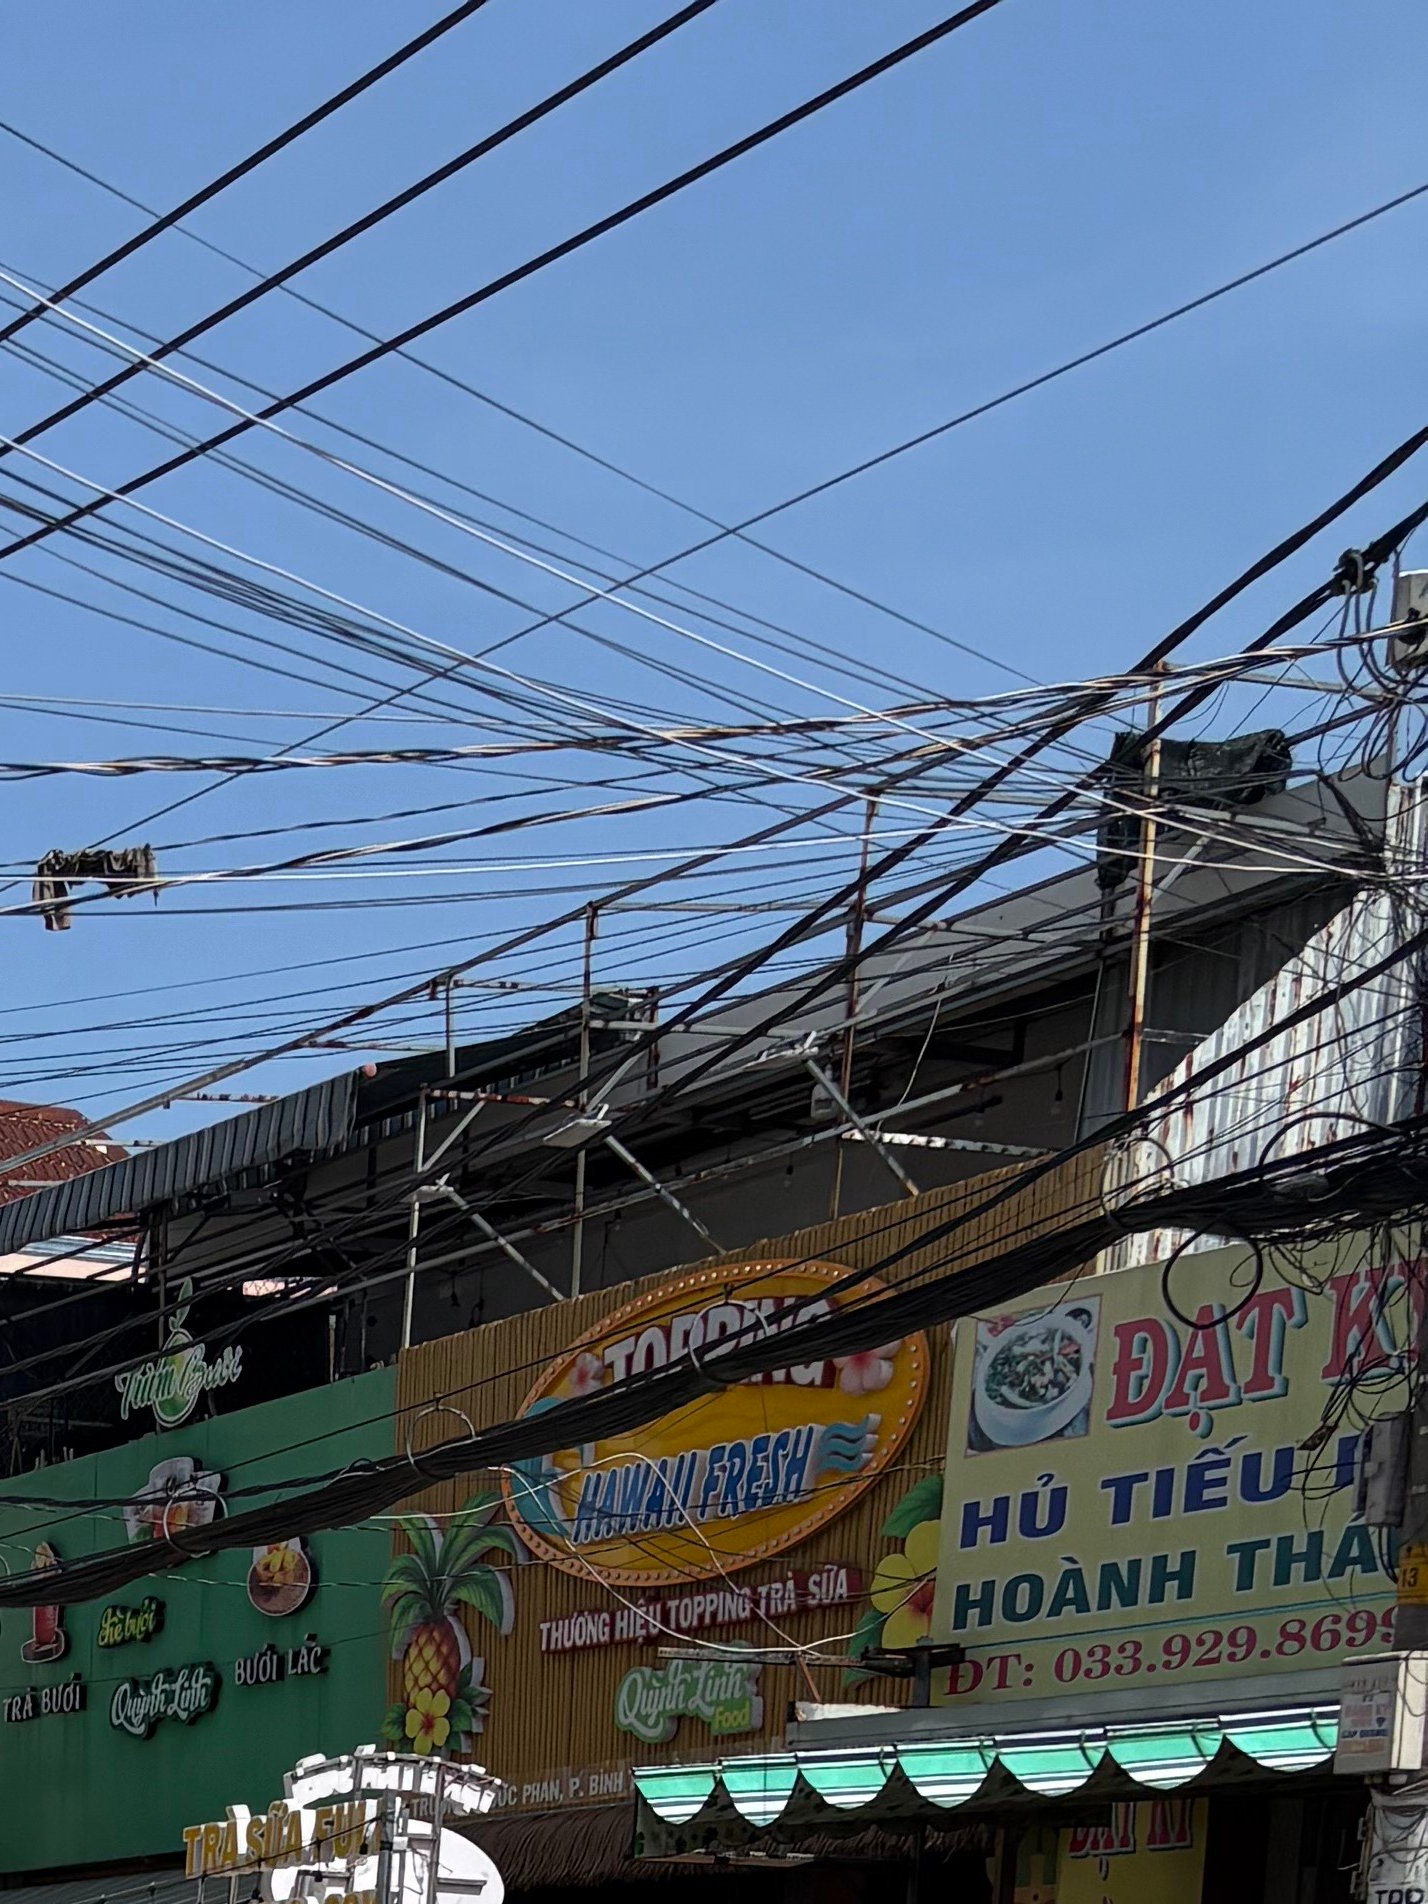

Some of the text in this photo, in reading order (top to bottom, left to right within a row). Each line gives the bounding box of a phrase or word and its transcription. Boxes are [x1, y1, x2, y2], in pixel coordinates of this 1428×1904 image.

[1107, 1256, 1428, 1438] ĐẠT K
[698, 1424, 818, 1520] FRESH
[960, 1473, 1068, 1549] HỦ
[1101, 1436, 1295, 1526] TIẾU
[666, 1590, 751, 1631] TOPPING
[952, 1556, 1197, 1632] HOÀNH
[714, 1701, 750, 1730] Food
